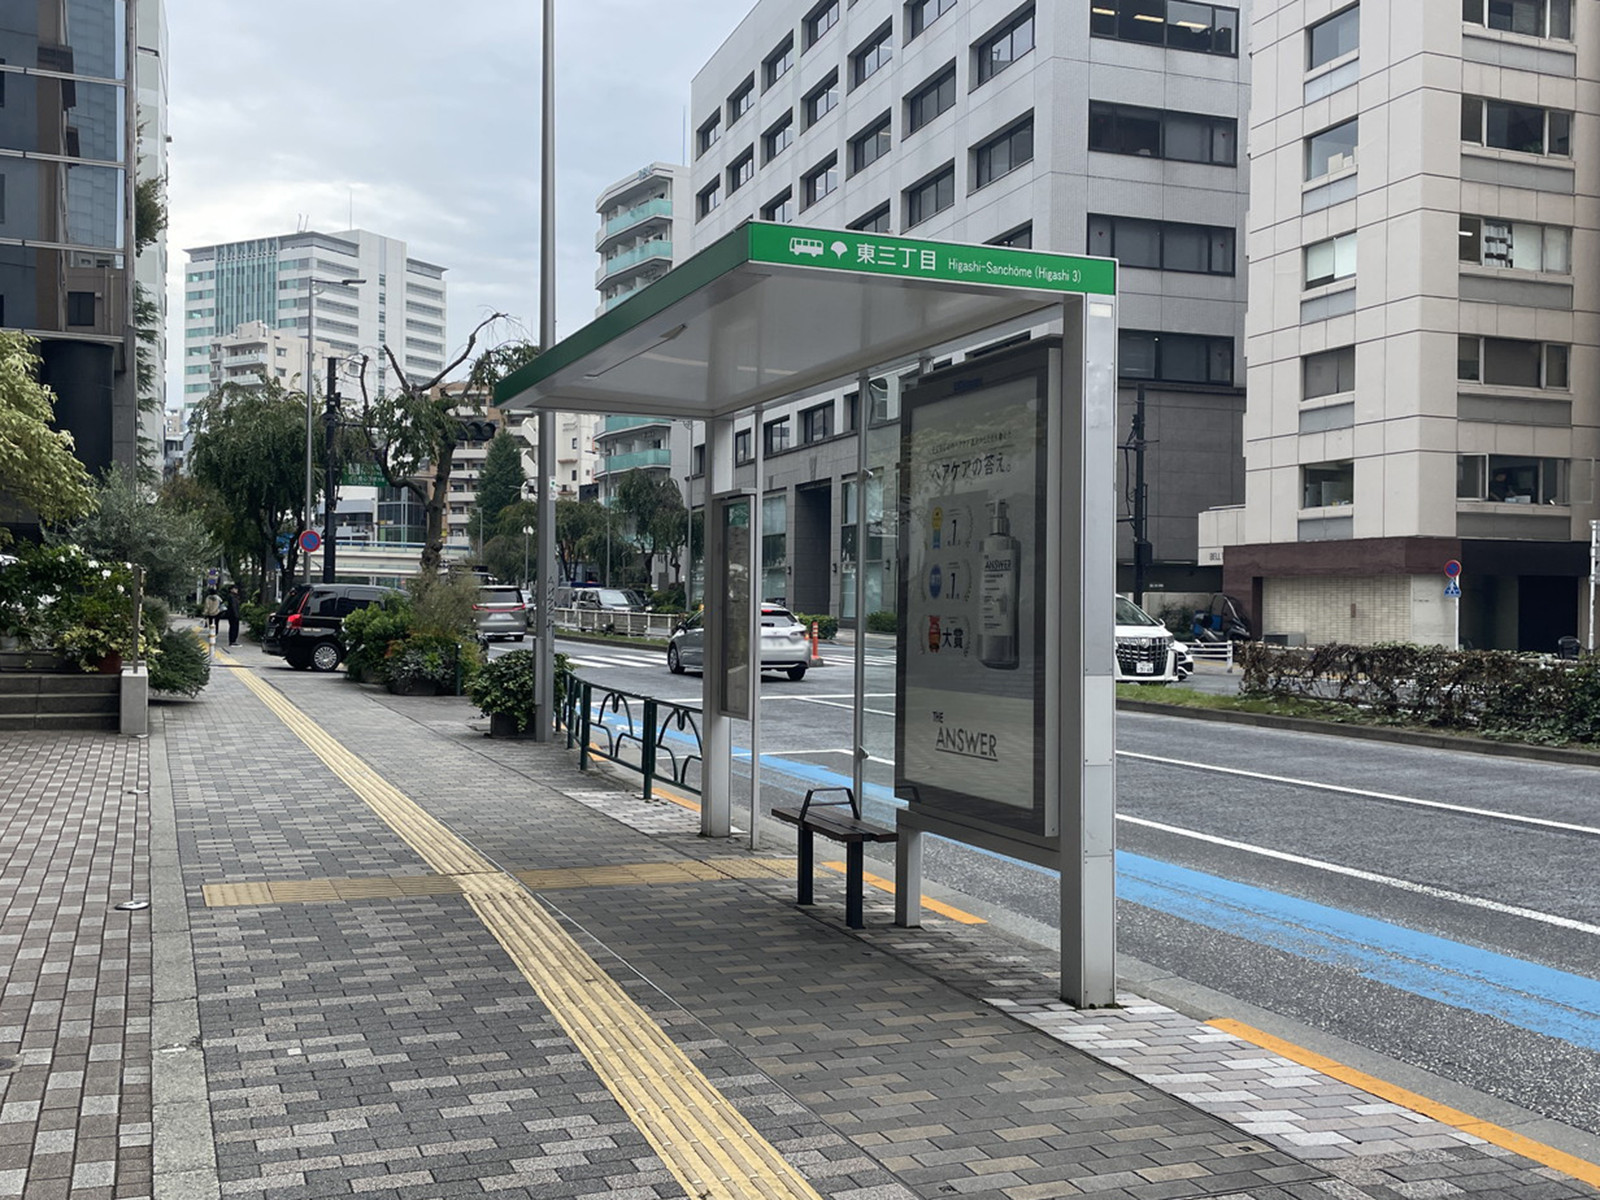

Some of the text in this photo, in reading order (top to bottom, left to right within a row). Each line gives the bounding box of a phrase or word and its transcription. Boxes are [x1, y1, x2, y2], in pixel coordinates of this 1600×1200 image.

[856, 242, 936, 271] 東三丁目
[1035, 265, 1070, 282] (Higashi
[1071, 269, 1082, 283] 3)
[932, 711, 944, 723] THE
[936, 727, 997, 757] ANSWER
